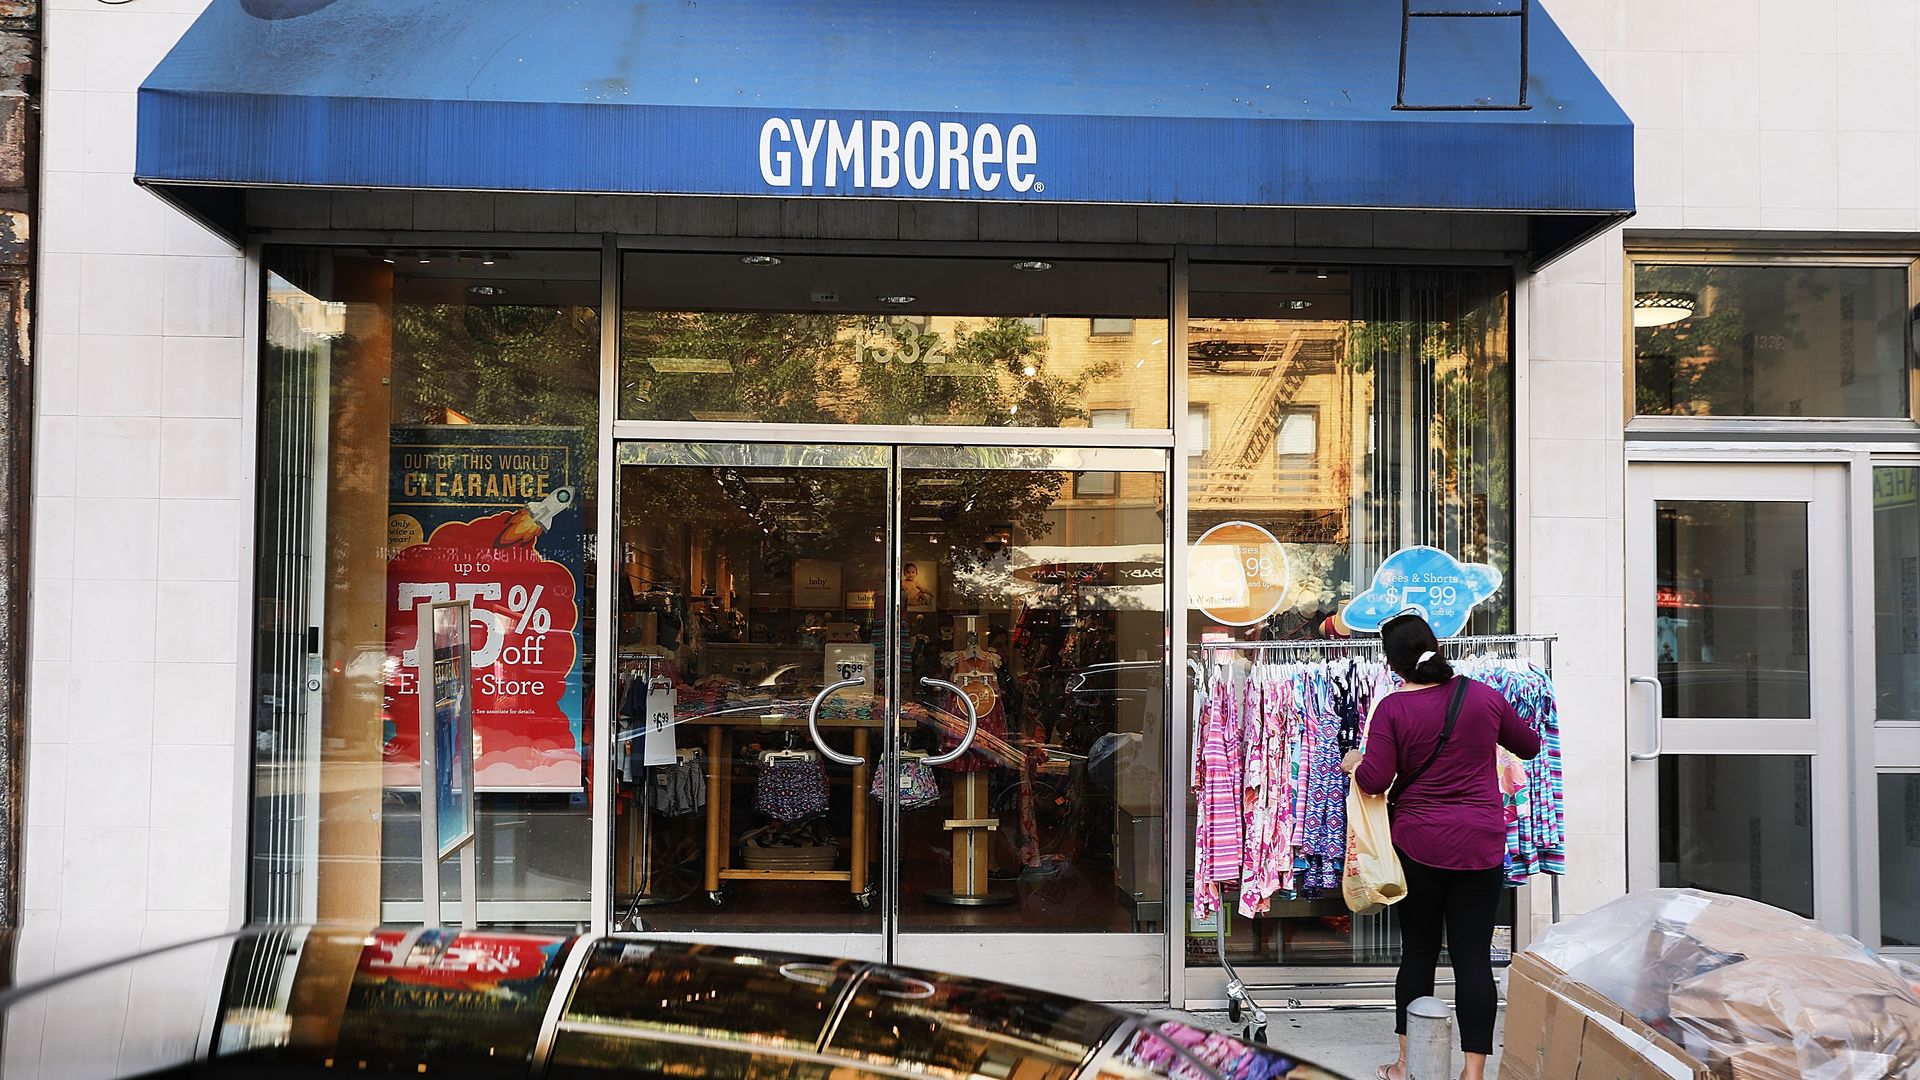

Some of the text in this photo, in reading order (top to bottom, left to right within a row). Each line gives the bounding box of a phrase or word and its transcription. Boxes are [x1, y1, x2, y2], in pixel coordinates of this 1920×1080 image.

[855, 320, 946, 364] 1332
[404, 453, 550, 471] OUT OF THIS WORLD
[404, 472, 550, 498] CLEARANCE
[390, 520, 410, 529] Only
[388, 536, 411, 545] year!
[454, 562, 491, 576] up to
[808, 577, 827, 587] baby
[1412, 573, 1421, 583] &
[1423, 573, 1459, 584] Shorts
[1445, 609, 1455, 618] up
[502, 635, 546, 666] off
[481, 673, 545, 696] Store
